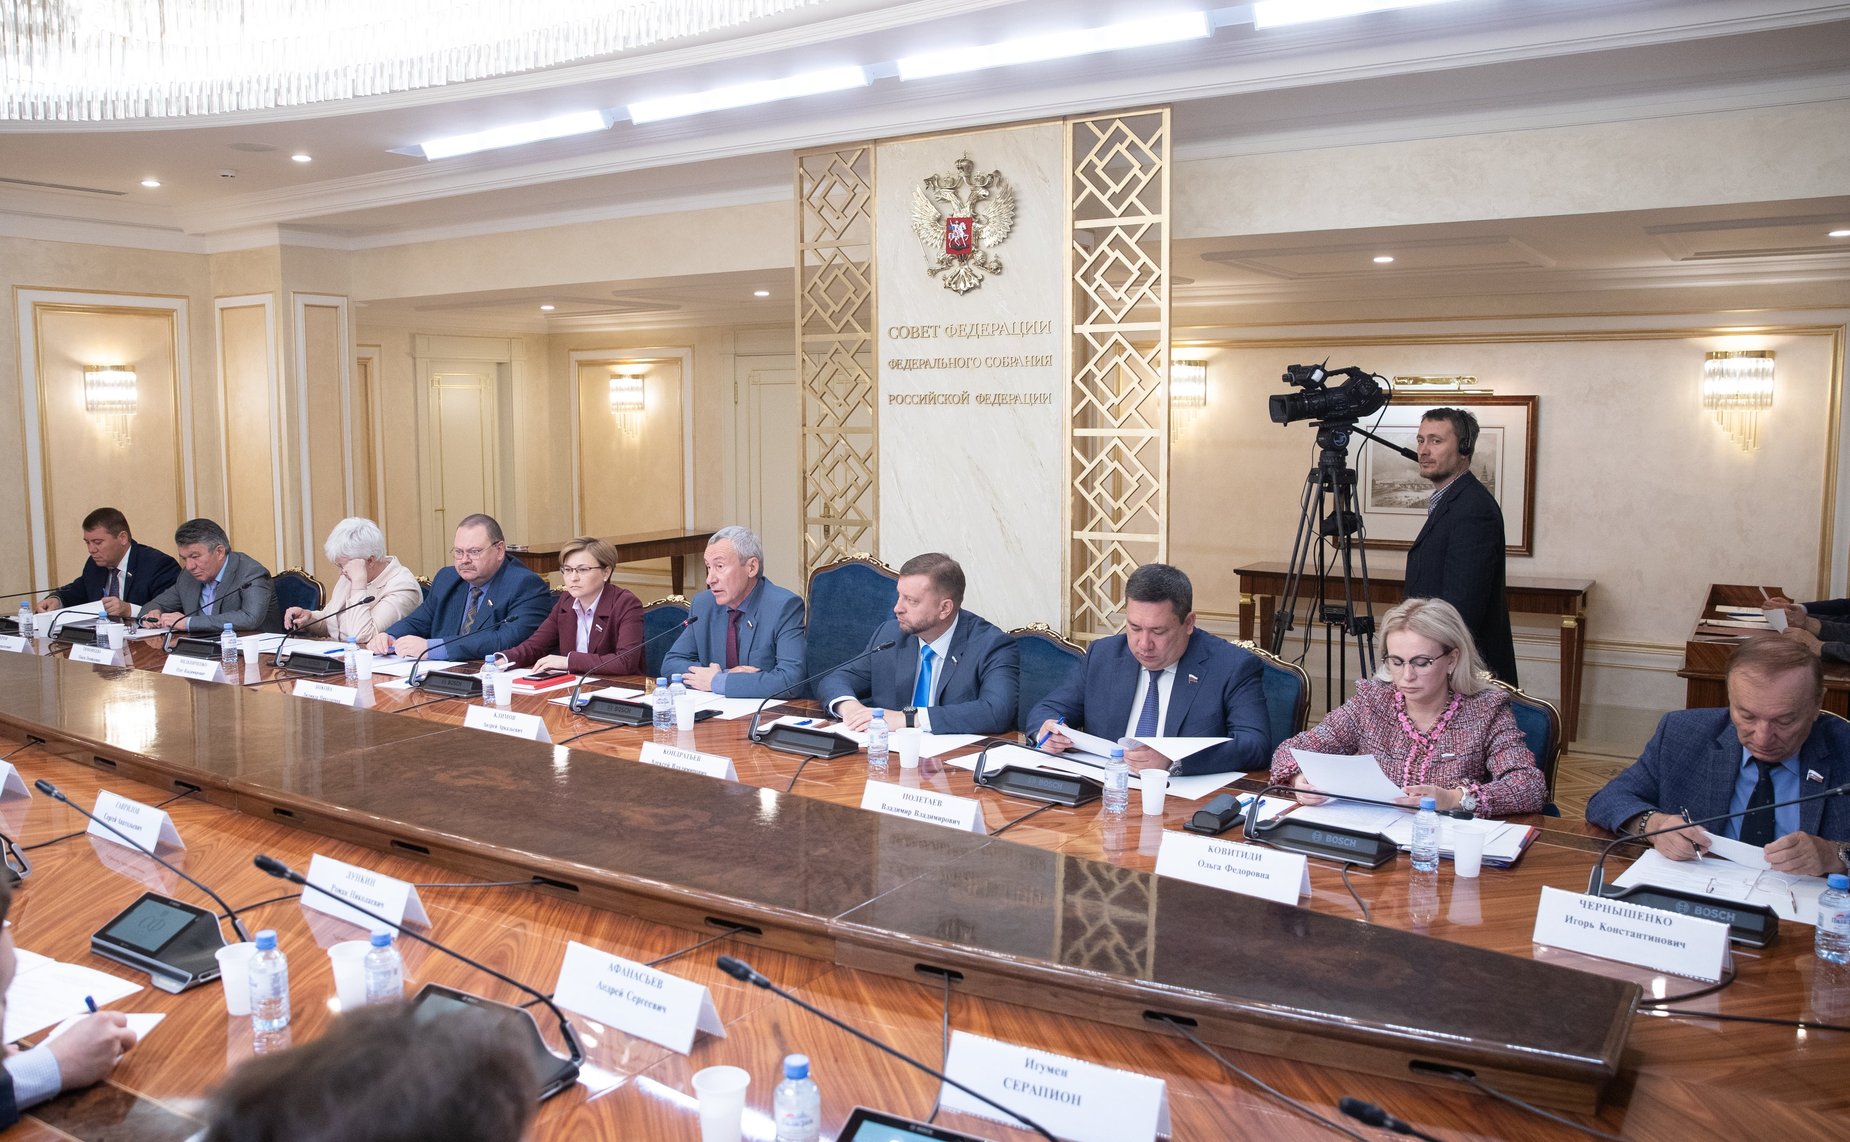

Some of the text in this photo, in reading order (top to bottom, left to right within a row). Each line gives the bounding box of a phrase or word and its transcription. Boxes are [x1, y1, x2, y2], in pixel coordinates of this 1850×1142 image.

[889, 320, 1052, 340] СОВЕТ ФЕДЕРАЦИИ
[889, 354, 1052, 371] ФЕДЕРАЛЬНОГО СОБРАНИЯ
[889, 390, 1052, 406] РОССИЙСКОЙ ФЕДЕРАЦИИ
[662, 749, 702, 762] КОНДРАТЬЕВ
[1040, 778, 1063, 790] BOSCH
[902, 792, 944, 808] ПОЛЕТАЕВ
[881, 803, 961, 826] Владимир Владимирович
[1325, 835, 1356, 848] BOSCH
[1207, 845, 1262, 862] КОВИТИДИ
[345, 870, 377, 888] ЛУНКИН
[1197, 859, 1270, 881] Ольга Федоровна
[330, 883, 349, 898] Роман
[1579, 898, 1673, 928] ЧЕРНЫШЕНКО
[1694, 904, 1736, 923] BOSCH
[1564, 913, 1686, 950] Игорь Константинович
[608, 962, 664, 990] АФАНАСЬЕВ
[597, 980, 667, 1015] Андрей Сергеевич
[1024, 1056, 1069, 1080] Игумен
[1002, 1077, 1082, 1108] СЕРАПИОН
